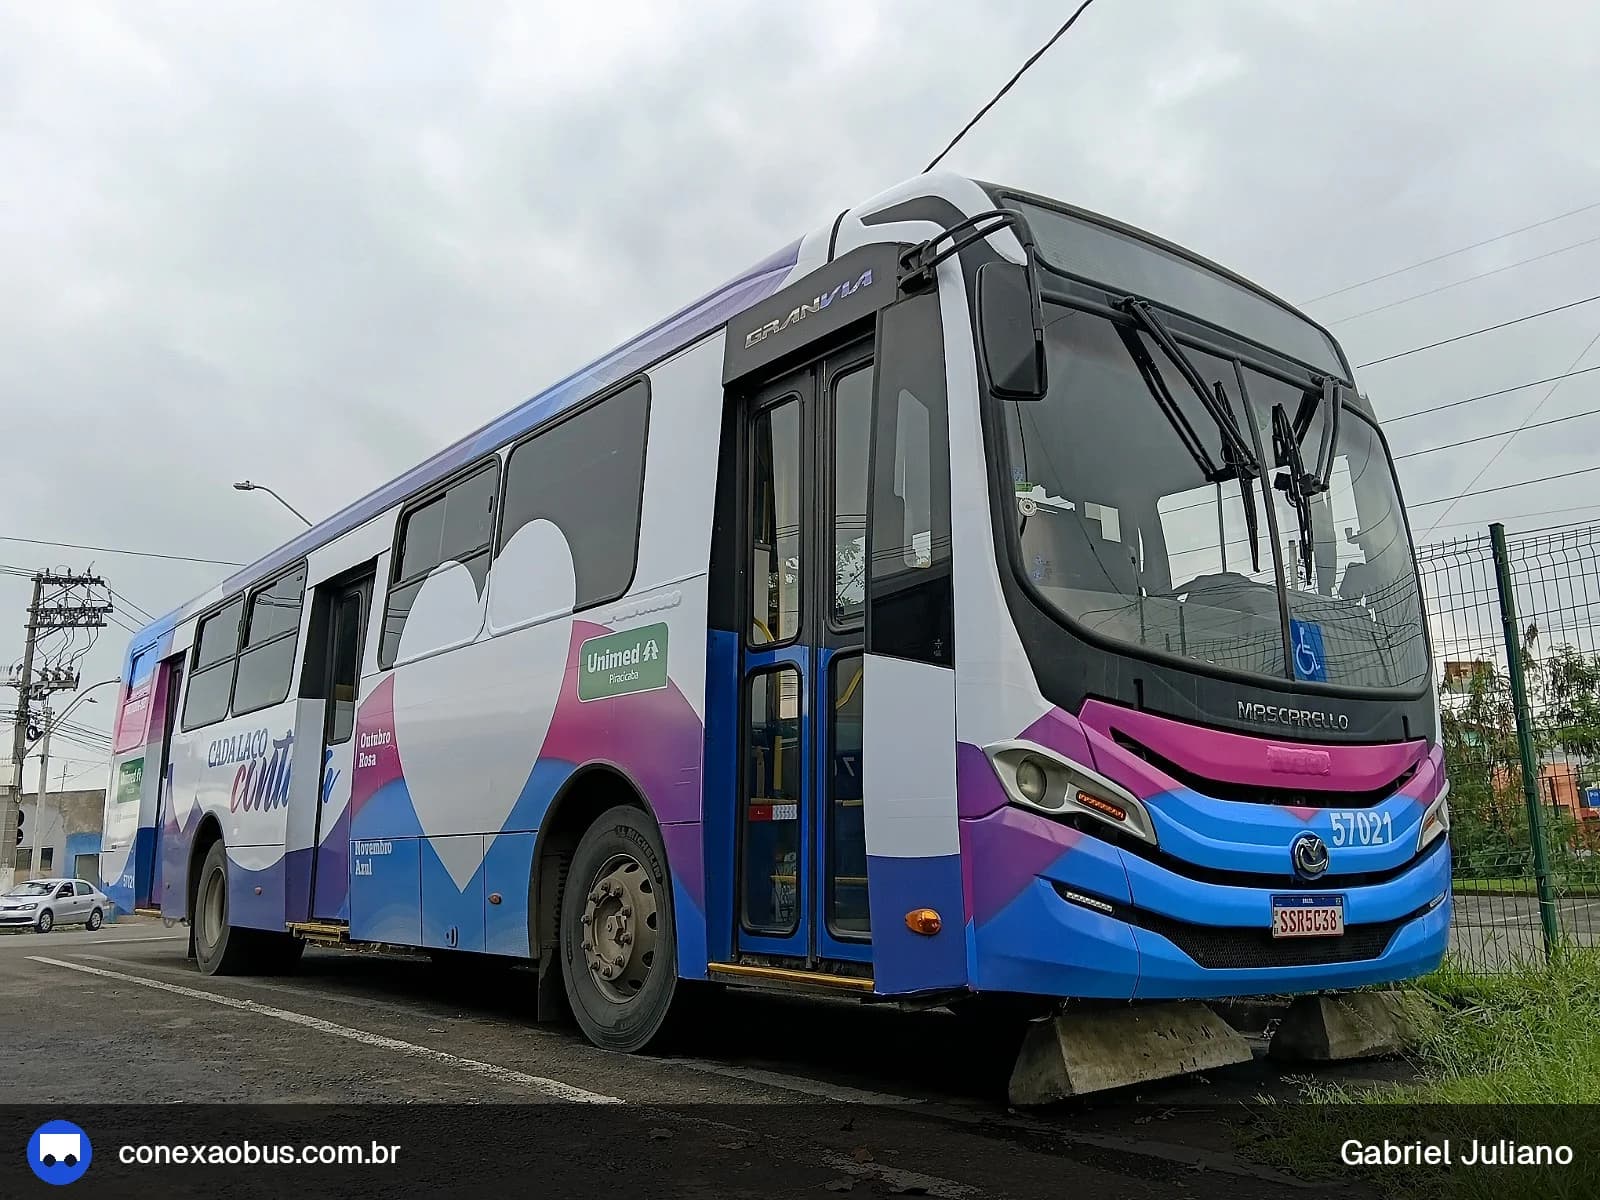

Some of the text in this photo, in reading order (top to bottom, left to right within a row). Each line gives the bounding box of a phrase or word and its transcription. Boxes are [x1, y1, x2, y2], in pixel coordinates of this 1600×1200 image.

[744, 269, 873, 349] GRANVIA
[587, 643, 640, 673] Unimed
[609, 669, 639, 684] Piracicaba
[1238, 701, 1349, 730] MASCARELLO
[361, 728, 390, 748] Outubro
[208, 736, 236, 768] CADA
[359, 752, 376, 768] Rosa
[1330, 812, 1393, 846] 57021
[355, 841, 392, 855] Novembro
[355, 859, 372, 875] Azul
[1280, 909, 1337, 932] SSR5C38
